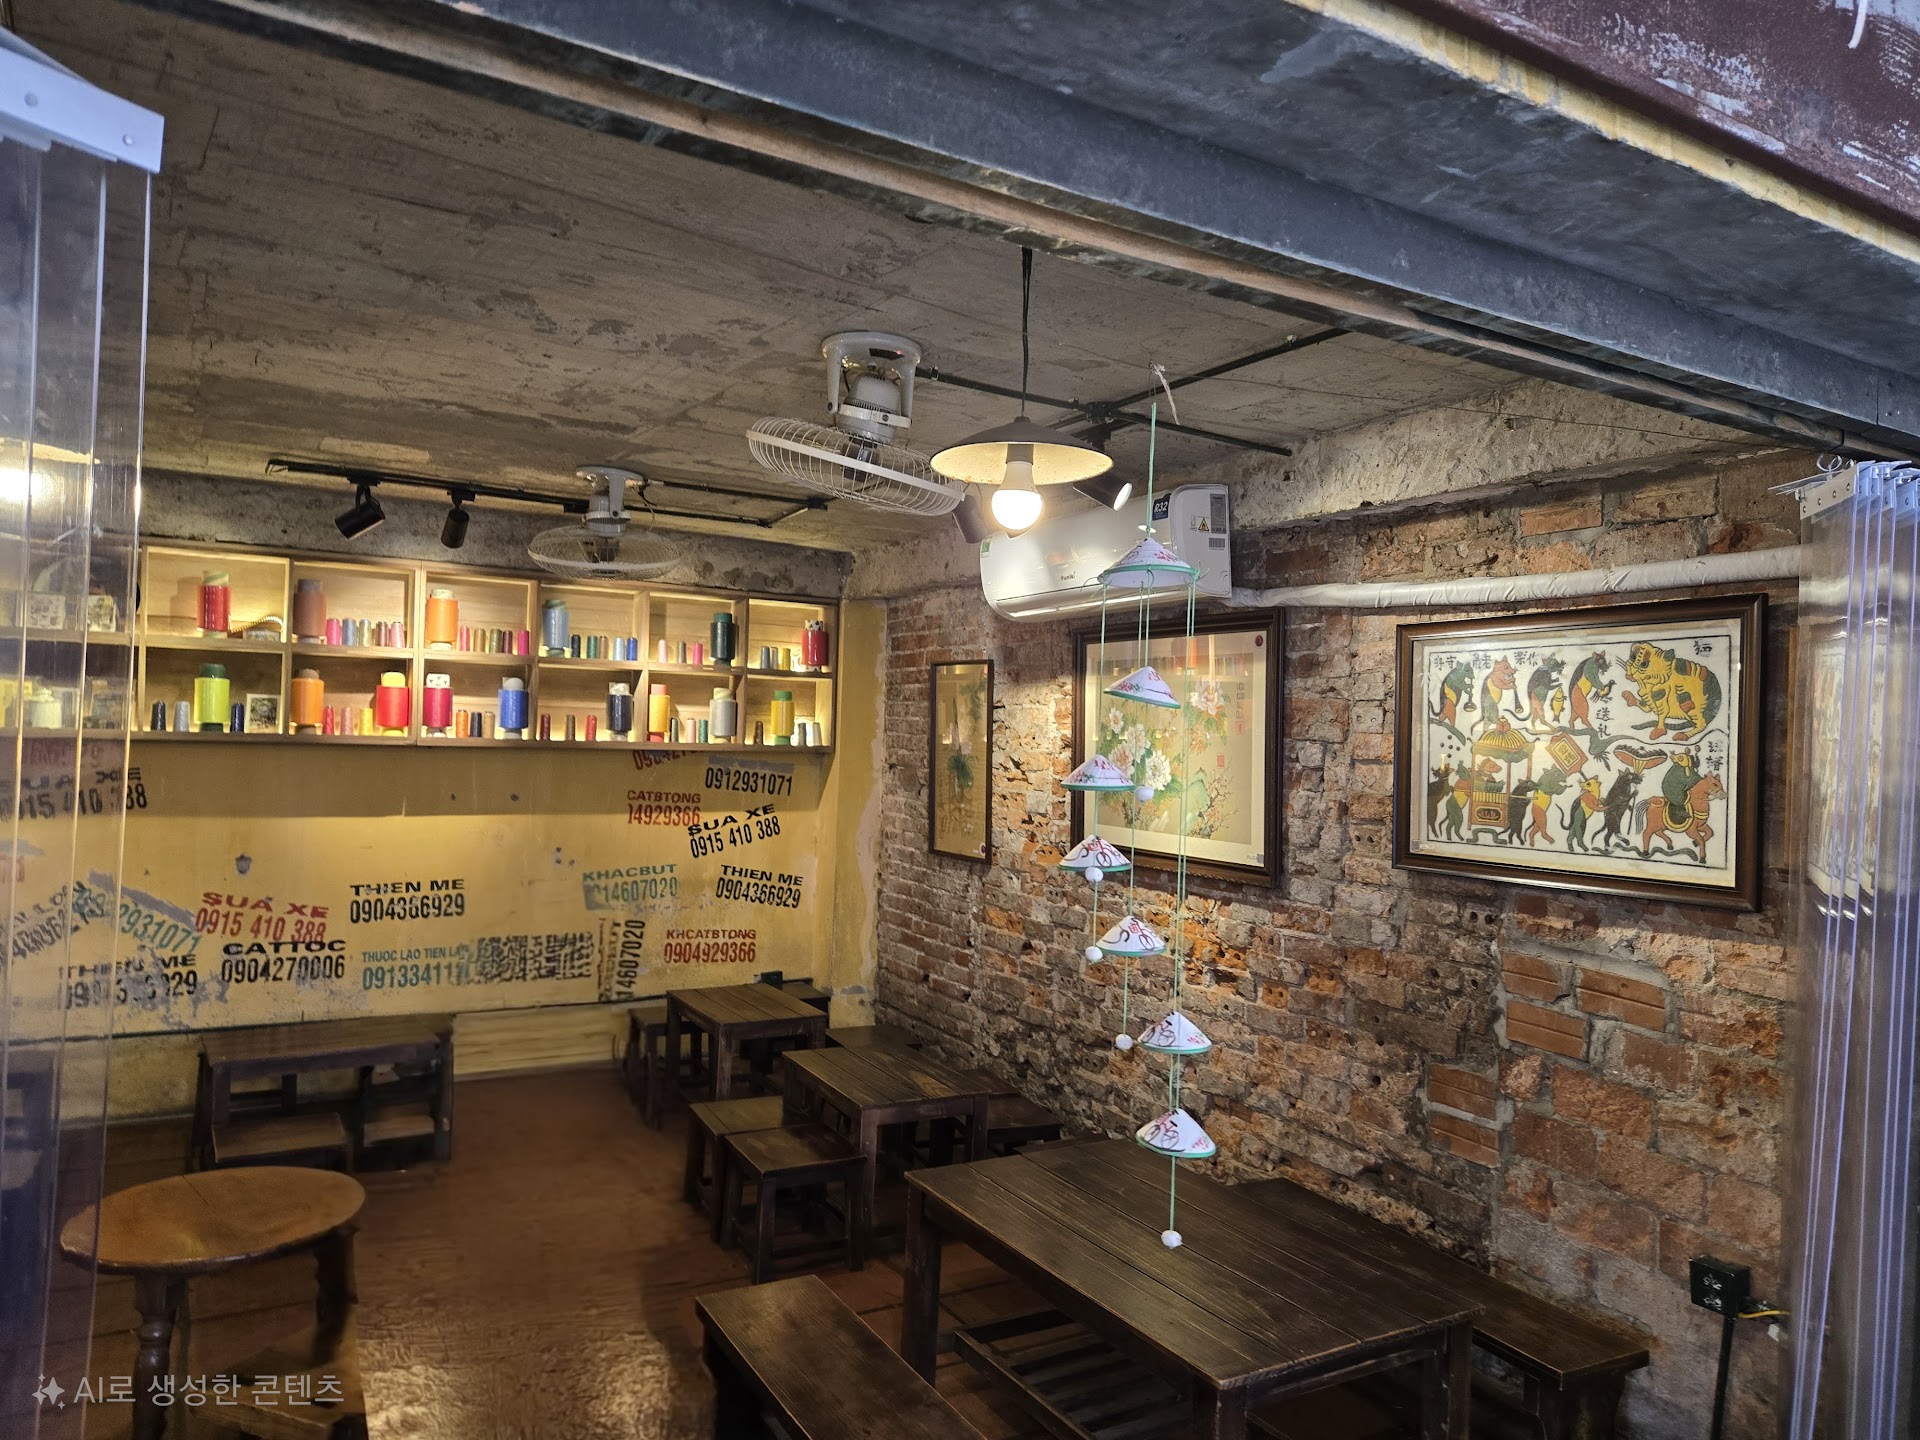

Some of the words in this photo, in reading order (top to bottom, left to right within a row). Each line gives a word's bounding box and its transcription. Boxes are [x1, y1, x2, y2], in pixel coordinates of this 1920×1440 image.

[705, 767, 793, 796] 0912931071
[687, 815, 738, 836] SUA
[745, 804, 776, 820] XE
[690, 832, 724, 858] 0915
[730, 823, 752, 847] 410
[756, 816, 781, 840] 388
[582, 864, 677, 881] KHACBUT
[721, 864, 773, 882] THIEN
[778, 873, 804, 887] ME
[350, 881, 421, 897] THIEN
[430, 879, 465, 891] ME
[716, 877, 802, 909] 0904366929
[202, 892, 273, 912] SUA
[285, 902, 329, 918] XE
[350, 893, 465, 924] 0904366929
[195, 908, 244, 937] 0915
[250, 914, 286, 941] 410
[291, 919, 327, 943] 388
[223, 940, 346, 956] CATTOC
[362, 950, 398, 962] THUOC
[400, 948, 421, 960] LAO
[424, 947, 446, 959] TIEN
[664, 941, 757, 964] 0904929366
[221, 954, 346, 984] 0904270006
